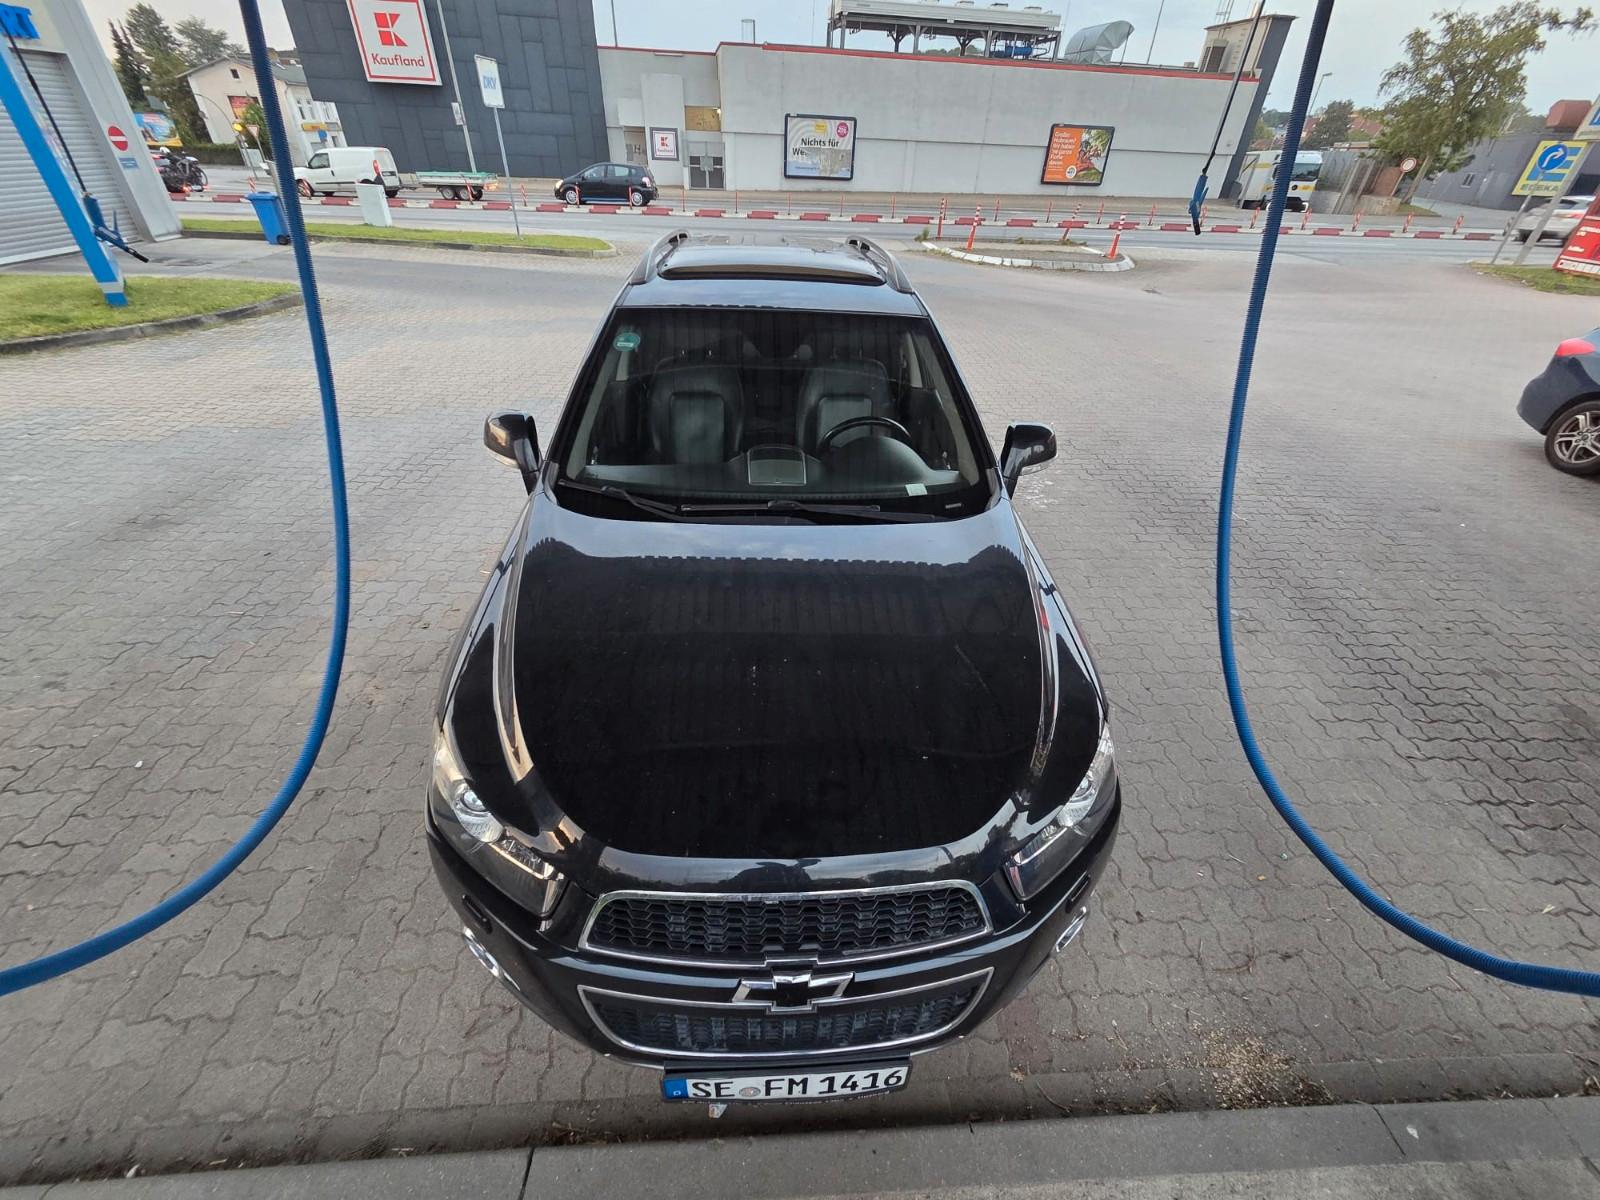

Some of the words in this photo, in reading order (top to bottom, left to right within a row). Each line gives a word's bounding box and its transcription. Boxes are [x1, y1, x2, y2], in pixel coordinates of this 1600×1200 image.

[371, 52, 426, 68] Kaufland
[482, 75, 497, 90] DKV
[801, 137, 826, 147] Nichts
[828, 138, 840, 147] für
[1519, 183, 1561, 193] EDEKA
[691, 1081, 735, 1098] SE
[764, 1077, 809, 1096] FM
[818, 1070, 903, 1095] 1416
